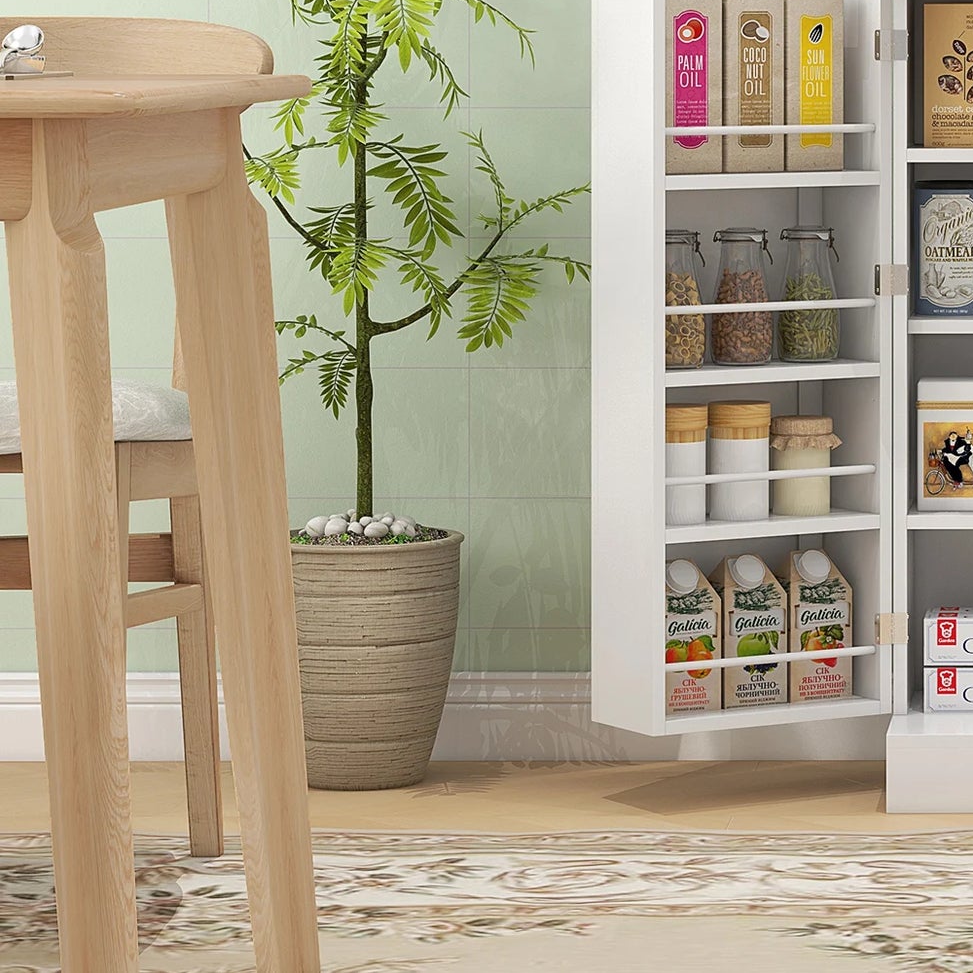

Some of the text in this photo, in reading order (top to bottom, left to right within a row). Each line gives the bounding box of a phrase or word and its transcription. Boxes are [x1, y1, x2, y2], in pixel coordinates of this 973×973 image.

[678, 55, 703, 71] PALM
[743, 47, 767, 63] COCO
[807, 49, 825, 65] SUN
[746, 63, 764, 79] NUT
[802, 66, 830, 81] FLOWER
[679, 71, 702, 88] OIL
[744, 80, 766, 96] OIL
[805, 81, 827, 97] OIL
[931, 105, 964, 113] dorset
[923, 207, 973, 245] Organic
[735, 614, 780, 632] Galicia
[800, 608, 845, 625] Galicia
[668, 618, 712, 637] Galicia
[682, 679, 697, 687] СІК
[736, 682, 779, 691] ЯБЛУЧНО-
